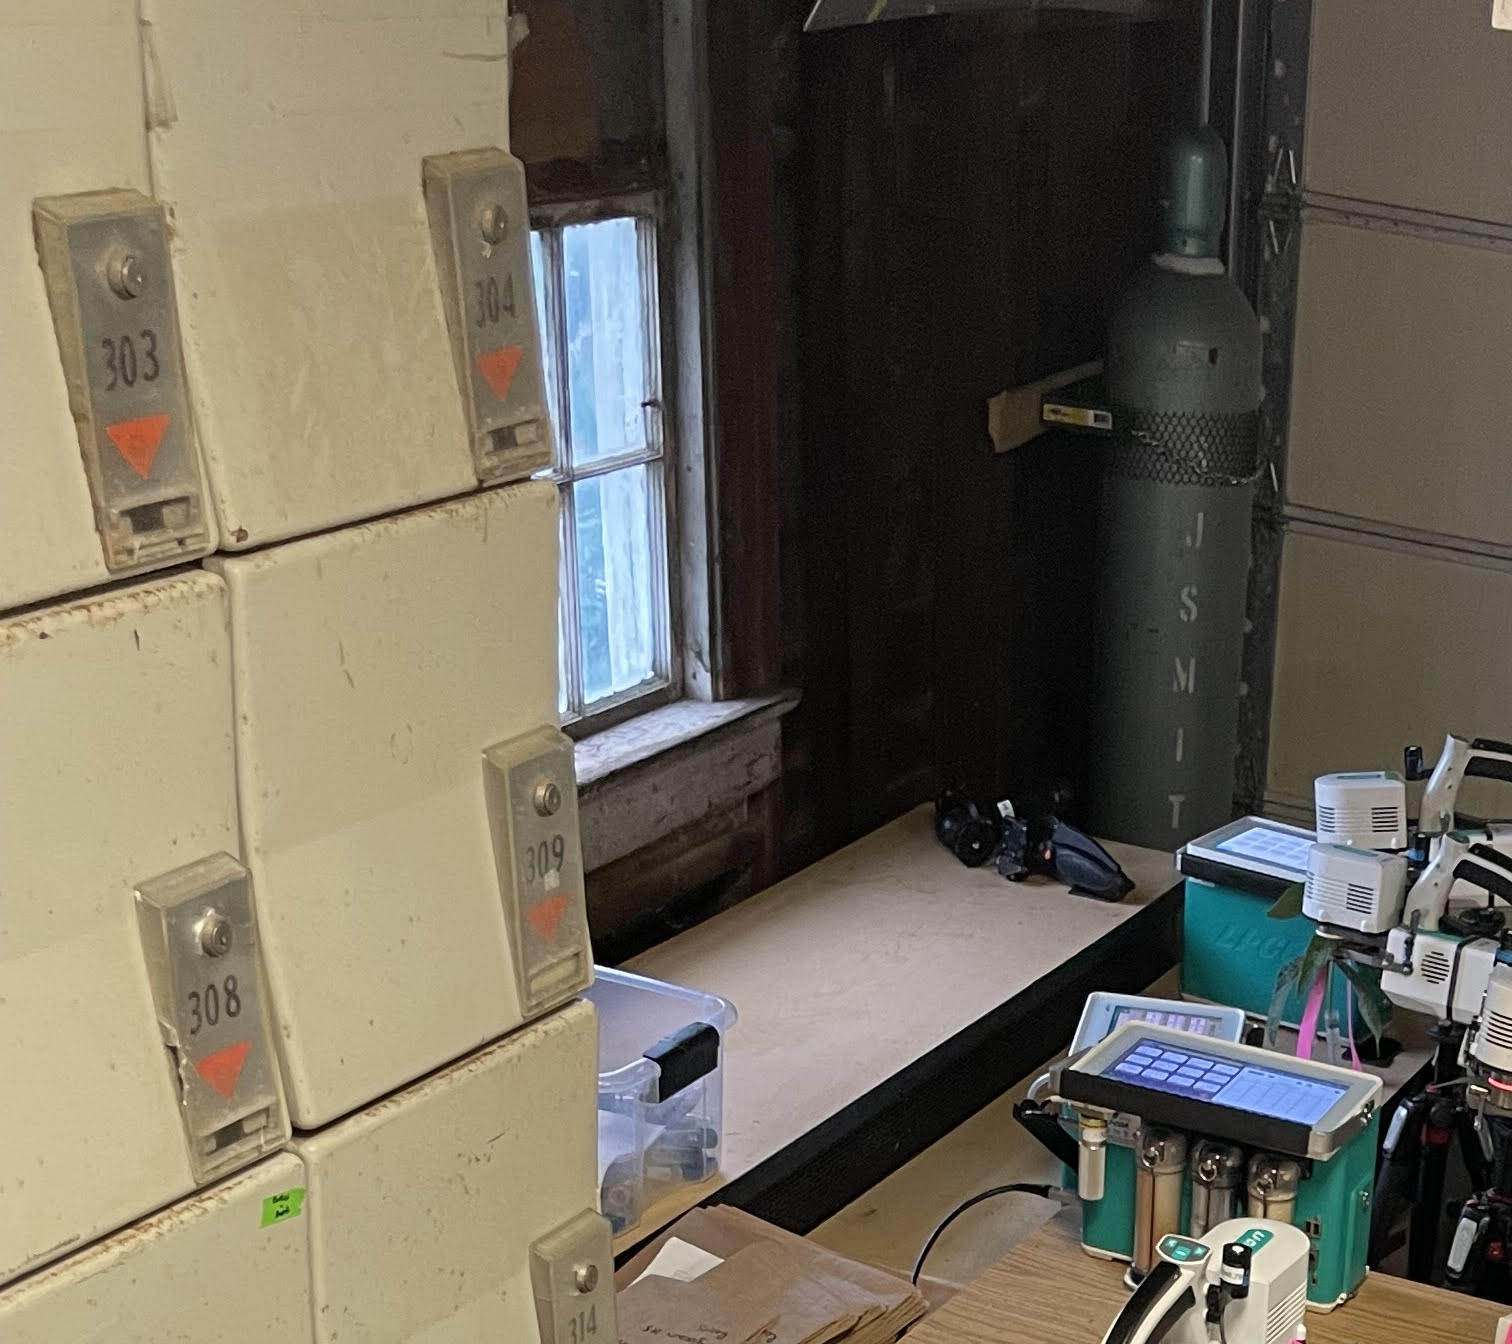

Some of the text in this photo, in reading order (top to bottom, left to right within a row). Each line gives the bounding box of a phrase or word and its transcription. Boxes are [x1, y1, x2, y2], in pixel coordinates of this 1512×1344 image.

[475, 273, 516, 328] 304
[102, 330, 160, 391] 303
[527, 834, 564, 885] 309
[190, 974, 240, 1035] 308
